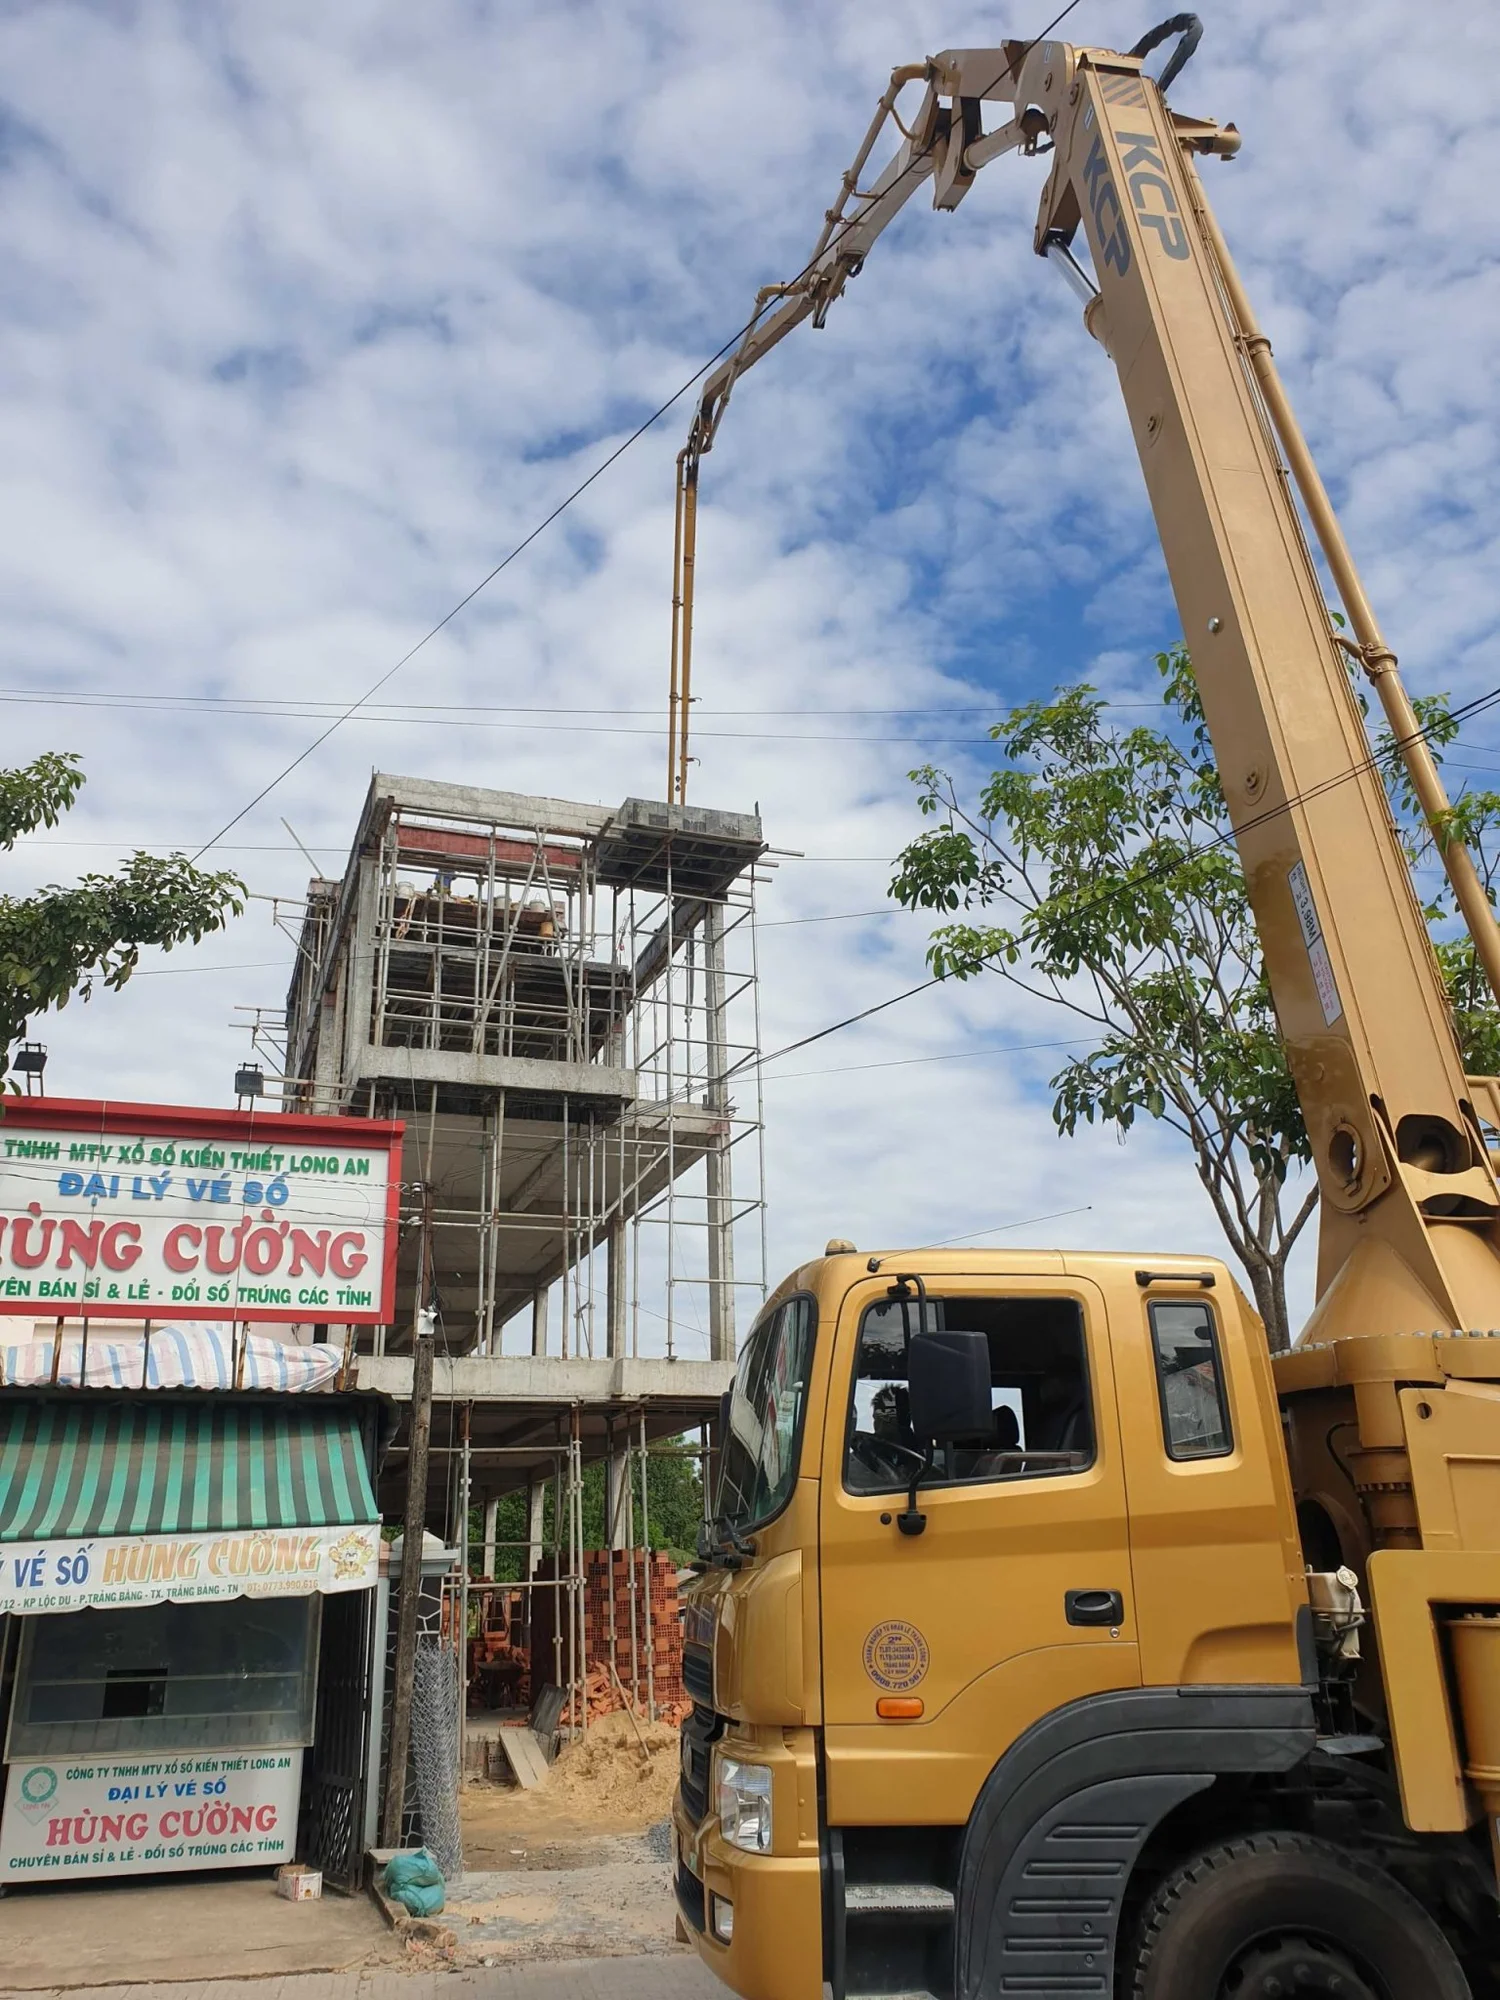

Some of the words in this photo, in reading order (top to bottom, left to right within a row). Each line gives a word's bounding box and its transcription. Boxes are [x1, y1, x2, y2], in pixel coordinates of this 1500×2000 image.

[1083, 134, 1131, 278] KCP
[1115, 131, 1190, 260] KCP
[5, 1139, 60, 1161] TNHH
[70, 1143, 112, 1164] MTV
[150, 1141, 176, 1165] SỐ
[181, 1143, 225, 1169] KIẾN
[231, 1146, 284, 1171] THIẾT
[290, 1155, 339, 1174] LONG
[344, 1158, 369, 1176] AN
[58, 1172, 120, 1206] ĐẠI
[132, 1170, 173, 1200] LÝ
[186, 1173, 232, 1203] VÉ
[243, 1172, 289, 1206] SỐ
[163, 1209, 368, 1278] CƯỜNG
[38, 1277, 77, 1298] BÁN
[83, 1277, 101, 1298] SỈ
[107, 1284, 120, 1299] &
[128, 1279, 150, 1300] LẺ
[171, 1278, 200, 1301] ĐỔI
[207, 1280, 230, 1302] SỐ
[237, 1284, 291, 1304] TRÚNG
[298, 1286, 329, 1305] CÁC
[336, 1285, 372, 1306] TỈNH
[15, 1550, 46, 1588] VÉ
[55, 1543, 94, 1586] SỐ
[103, 1537, 203, 1585] HÙNG
[207, 1531, 321, 1578] CƯỜNG
[23, 1597, 36, 1608] KP
[38, 1594, 56, 1608] LỘC
[58, 1595, 71, 1606] DU
[119, 1589, 142, 1602] BÀNG
[151, 1589, 164, 1599] TX.
[197, 1583, 220, 1596] BÀNG
[228, 1584, 239, 1593] TN
[66, 1766, 94, 1780] CÔNG
[97, 1767, 110, 1778] TY
[113, 1765, 139, 1777] TNHH
[141, 1763, 162, 1776] MTV
[180, 1758, 194, 1773] SỐ
[195, 1757, 218, 1773] KIẾN
[221, 1756, 248, 1771] THIẾT
[251, 1757, 276, 1770] LONG
[277, 1757, 291, 1768] AN
[108, 1786, 139, 1804] ĐẠI
[145, 1781, 168, 1799] LÝ
[174, 1779, 197, 1797] VÉ
[203, 1775, 227, 1795] SỐ
[46, 1808, 149, 1847] HÙNG
[159, 1800, 277, 1839] CƯỜNG
[9, 1853, 60, 1868] CHUYÊN
[64, 1851, 89, 1865] BÁN
[107, 1852, 116, 1862] &
[120, 1847, 134, 1861] LẺ
[145, 1844, 165, 1859] ĐỔI
[169, 1843, 184, 1858] SỐ
[188, 1842, 227, 1857] TRÚNG
[231, 1840, 254, 1853] CÁC
[257, 1837, 284, 1852] TỈNH
